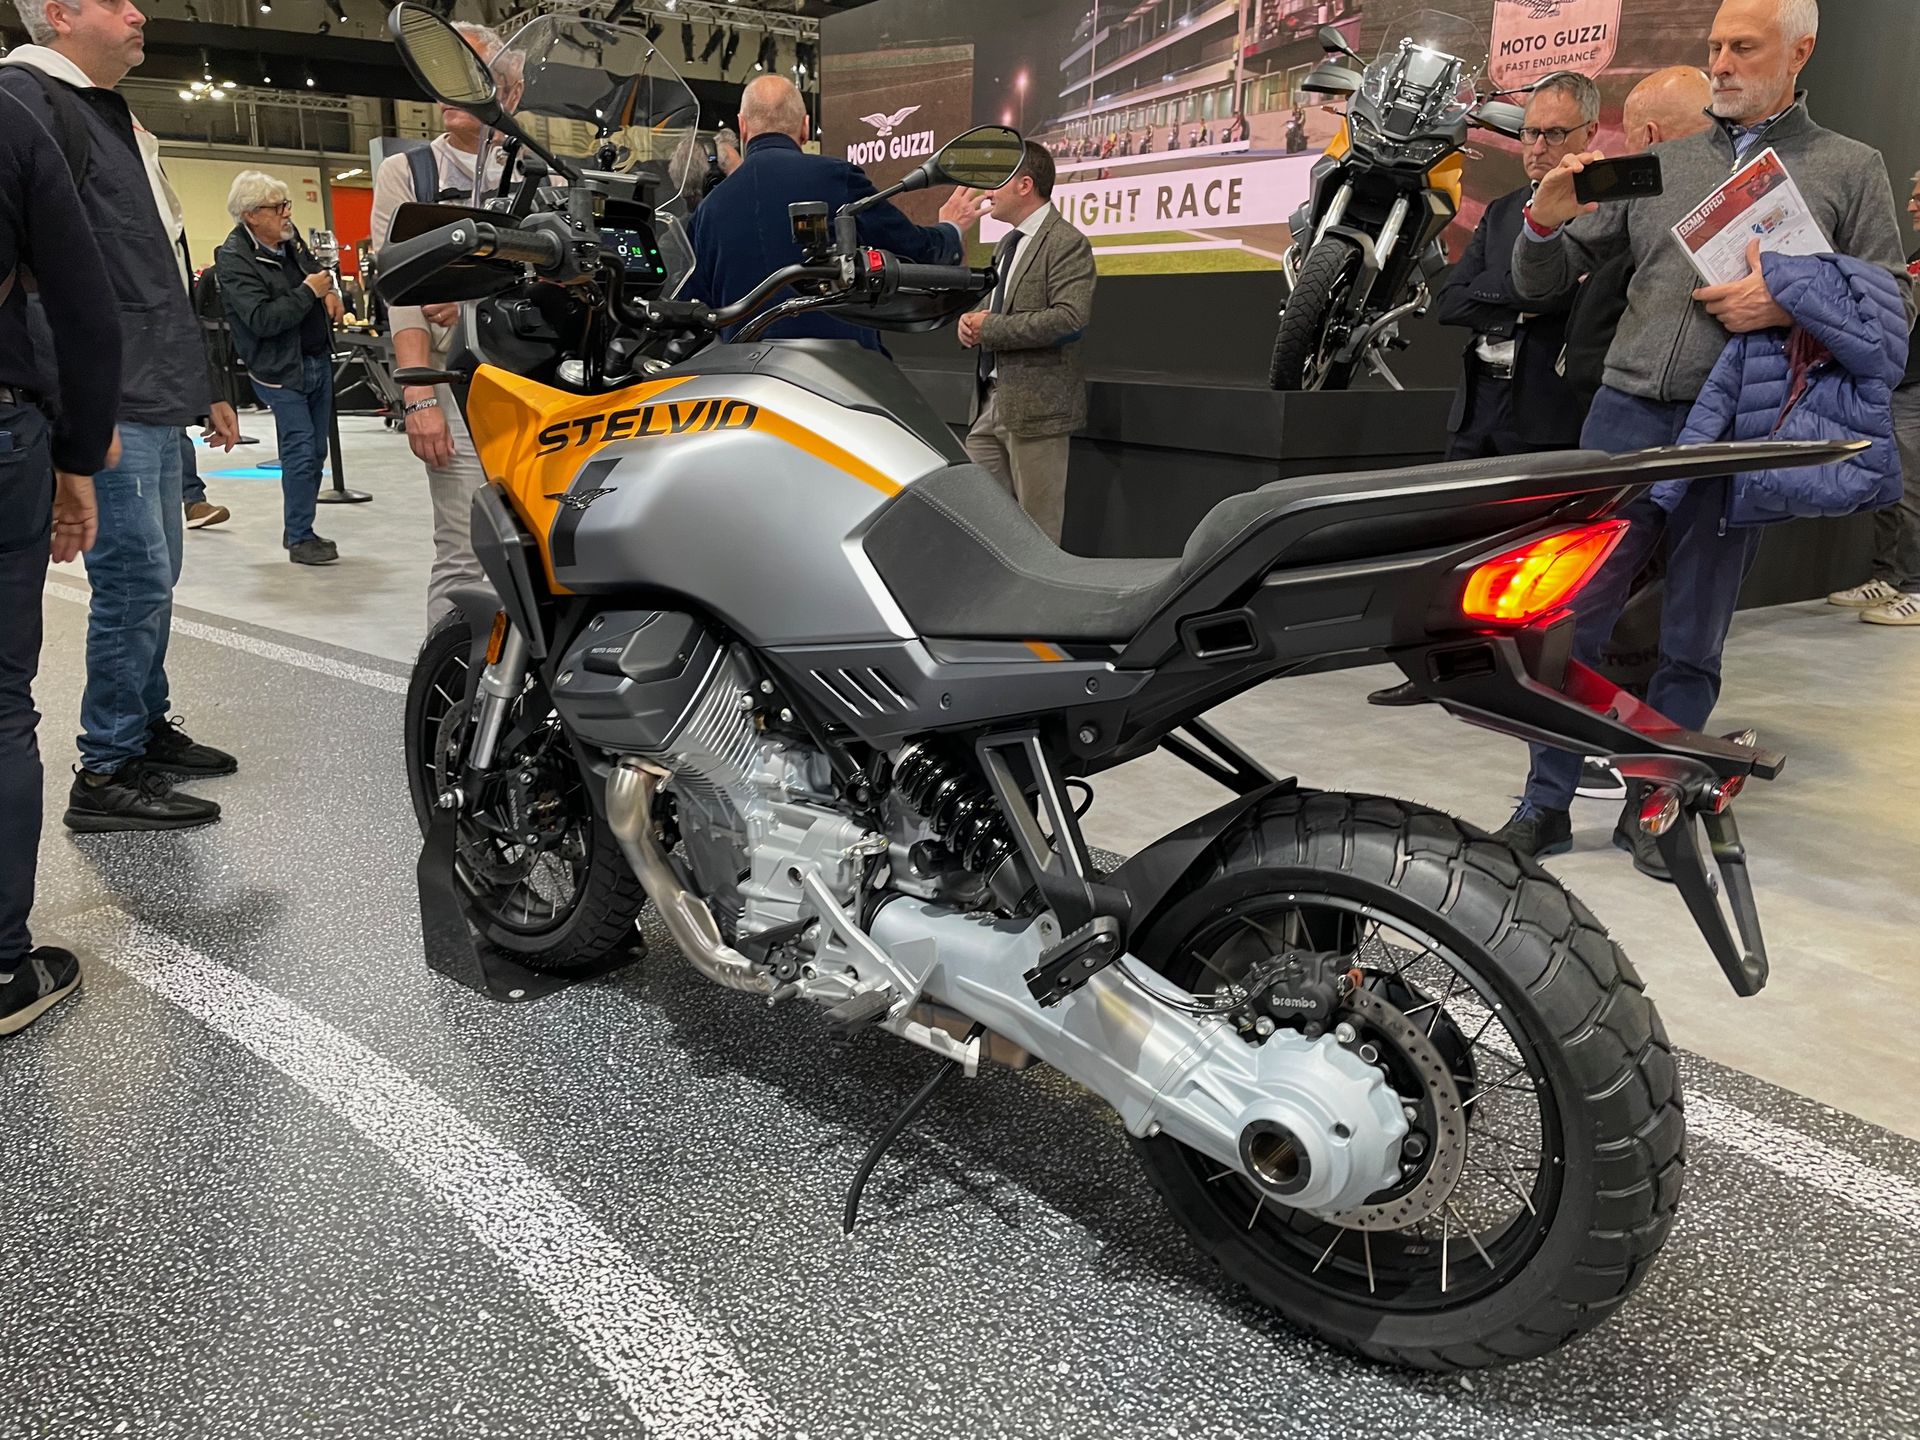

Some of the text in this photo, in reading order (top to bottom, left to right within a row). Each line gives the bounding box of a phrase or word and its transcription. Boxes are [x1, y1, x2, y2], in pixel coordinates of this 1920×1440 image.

[1500, 24, 1608, 57] MOTO GUZZI
[1505, 49, 1597, 73] FAST ENDURANCE
[847, 130, 935, 166] MOTO GUZZI
[1059, 177, 1243, 227] IGHT RACE
[1679, 212, 1704, 236] EICMA
[1701, 191, 1726, 218] EFFECT
[631, 246, 641, 255] N
[535, 399, 759, 459] STELVIO
[1272, 994, 1317, 1009] brembo
